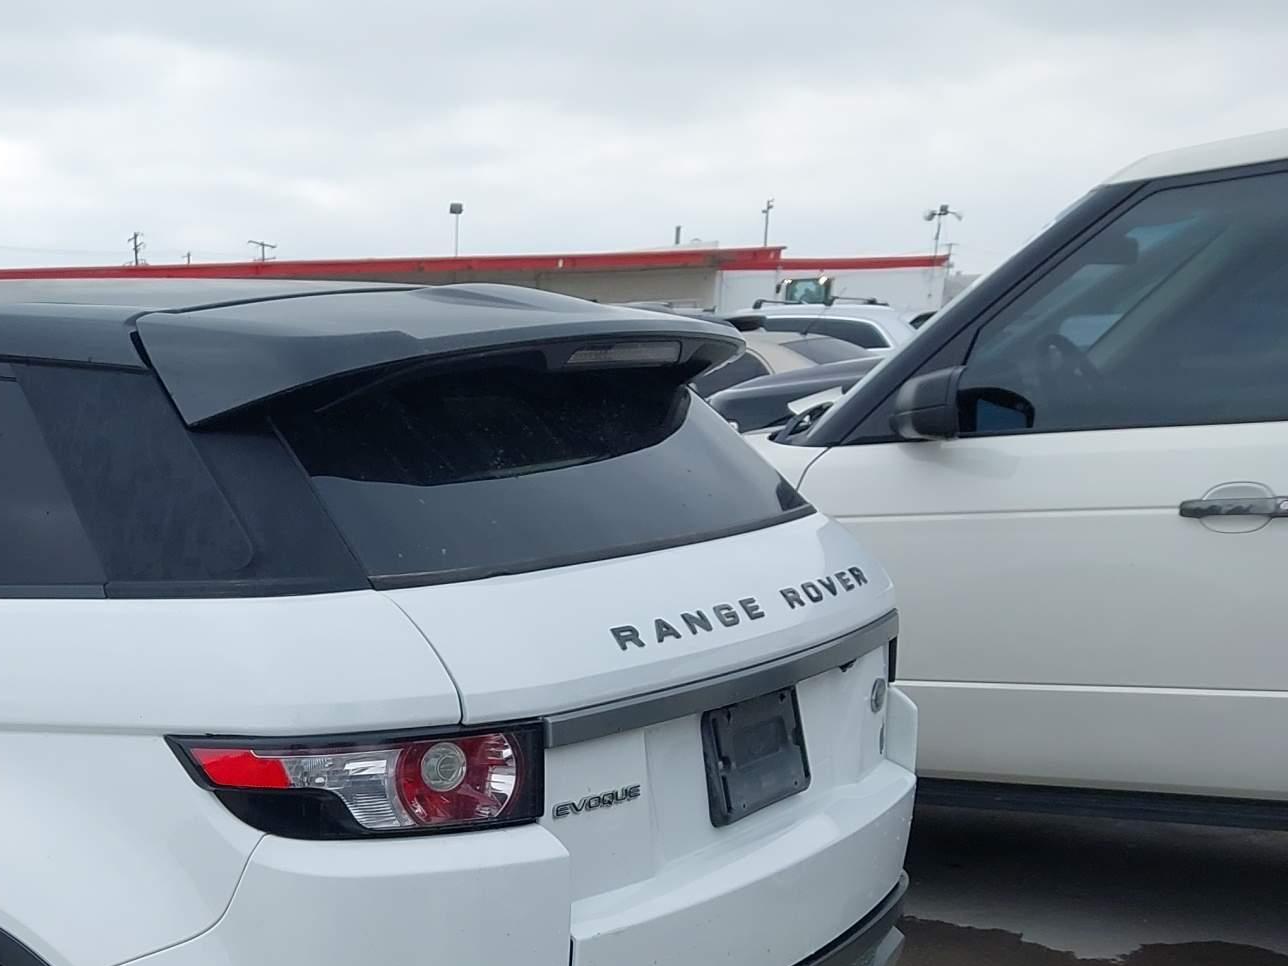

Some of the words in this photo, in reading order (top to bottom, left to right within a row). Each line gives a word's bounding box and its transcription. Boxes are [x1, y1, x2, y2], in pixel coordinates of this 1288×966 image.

[610, 597, 765, 651] RANGE
[779, 566, 868, 609] ROVER
[552, 784, 641, 820] EVOQUE
